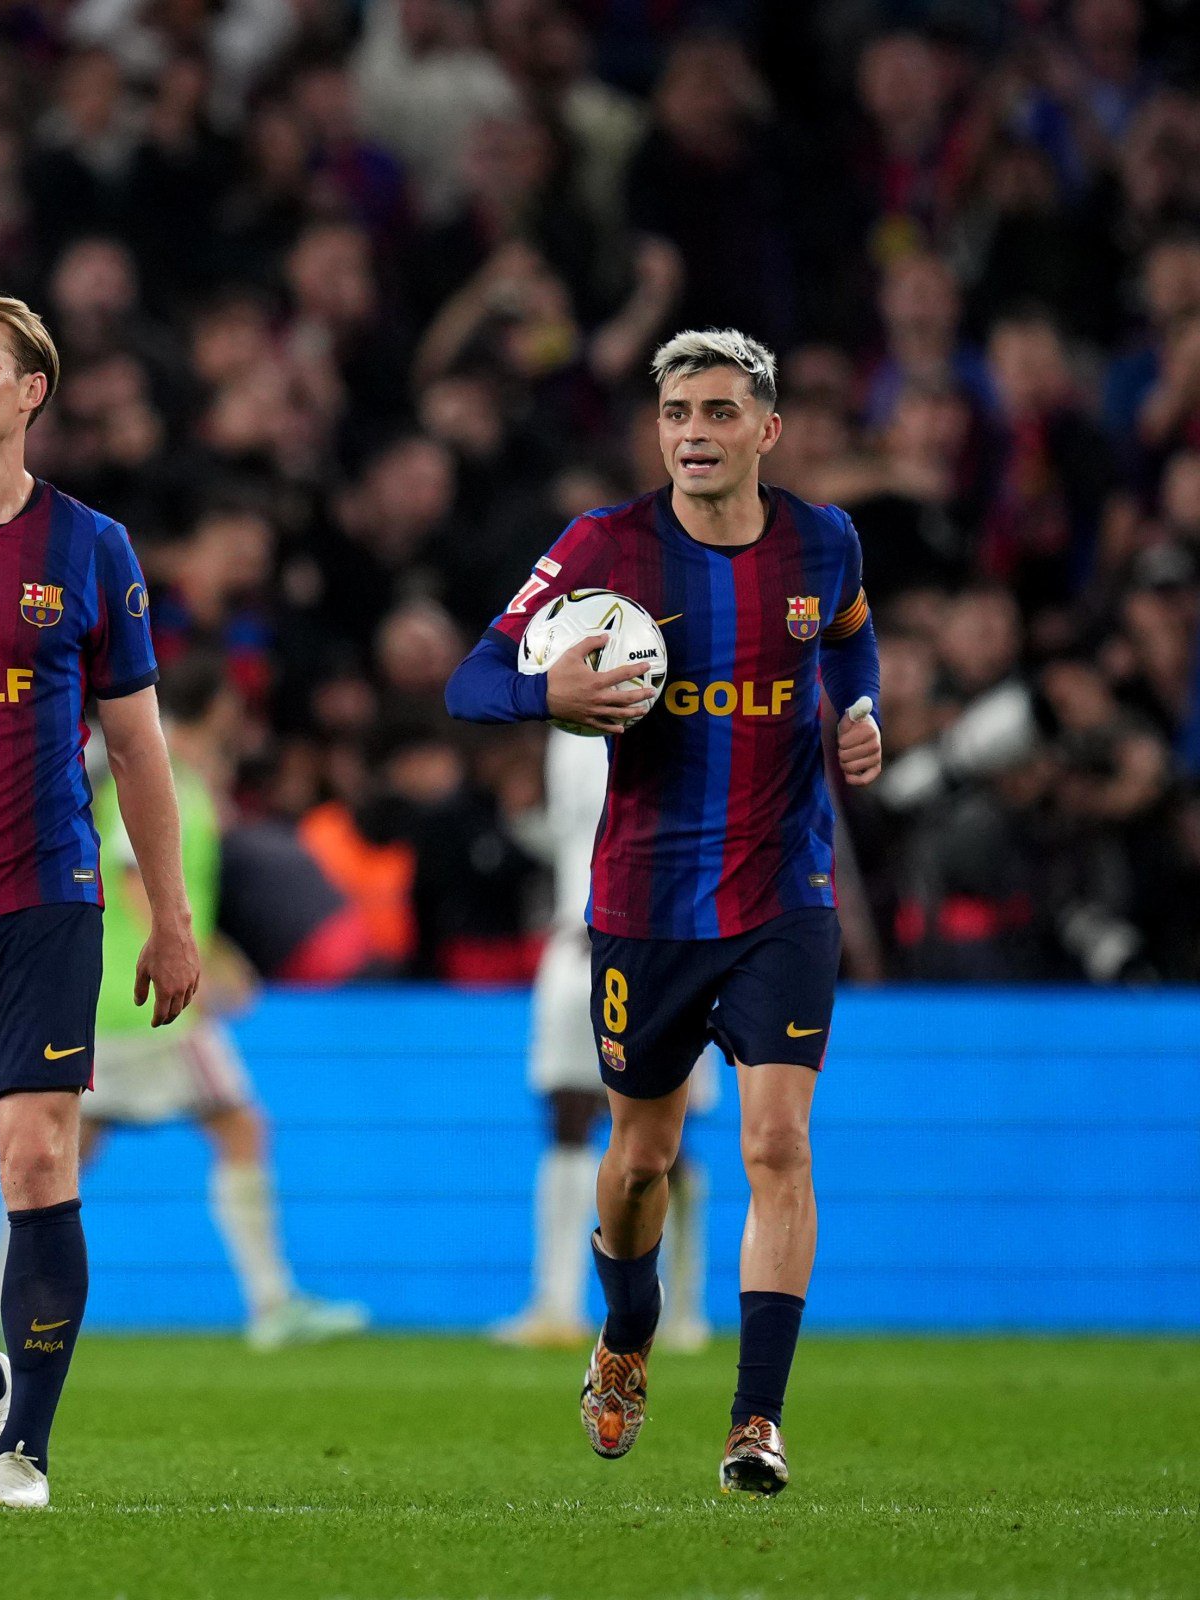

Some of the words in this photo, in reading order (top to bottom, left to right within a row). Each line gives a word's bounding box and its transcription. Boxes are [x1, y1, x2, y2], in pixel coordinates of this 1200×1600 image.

[629, 648, 659, 660] NITRO
[664, 680, 795, 717] GOLF
[603, 967, 628, 1034] 8
[24, 1338, 64, 1354] BARÇA
